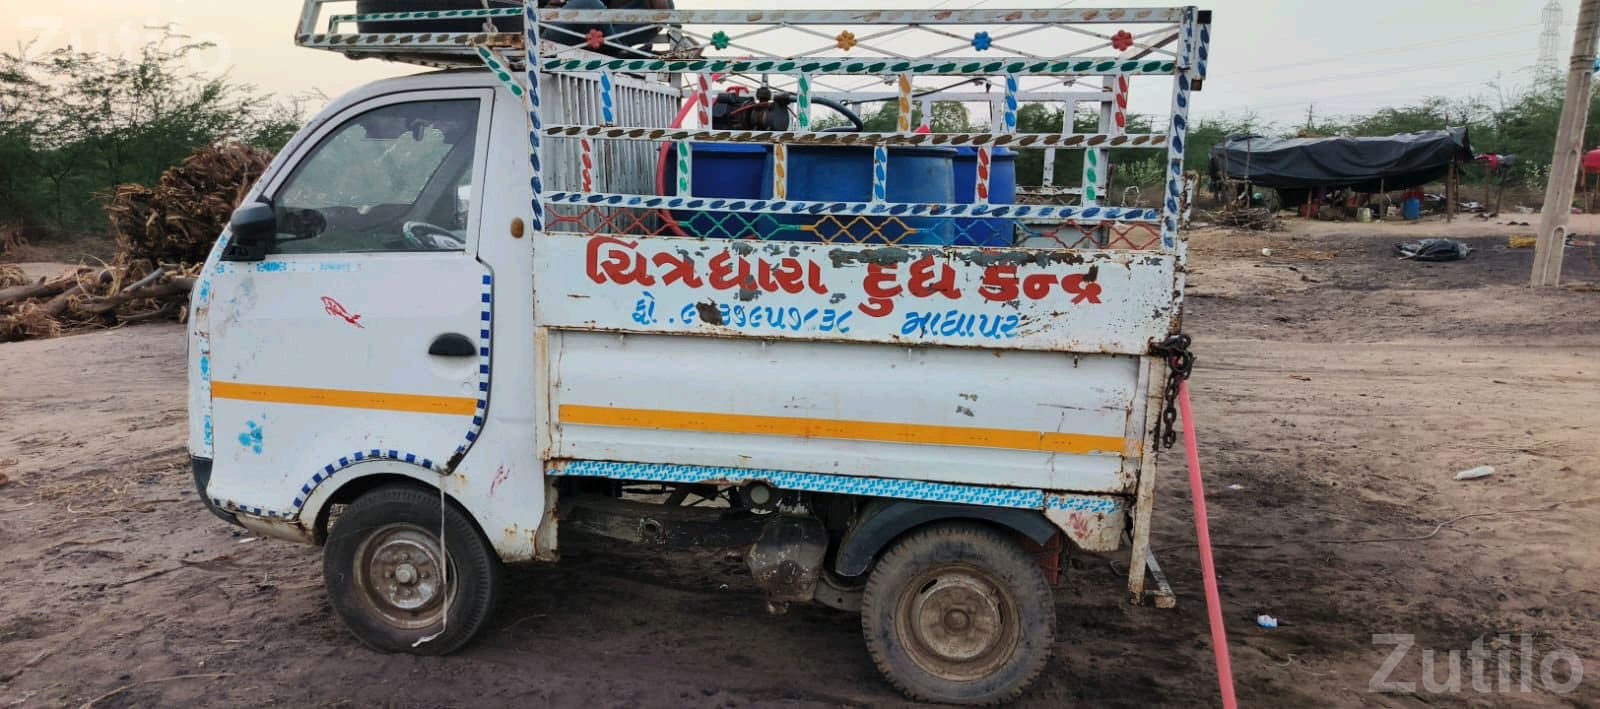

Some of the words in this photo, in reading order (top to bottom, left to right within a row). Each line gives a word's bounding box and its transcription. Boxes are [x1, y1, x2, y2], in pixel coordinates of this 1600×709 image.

[586, 236, 827, 294] ચિત્રધારા
[977, 249, 1102, 304] કન્દ્ર
[680, 302, 854, 334] ૯૩૭૯૫૭૮૩૮
